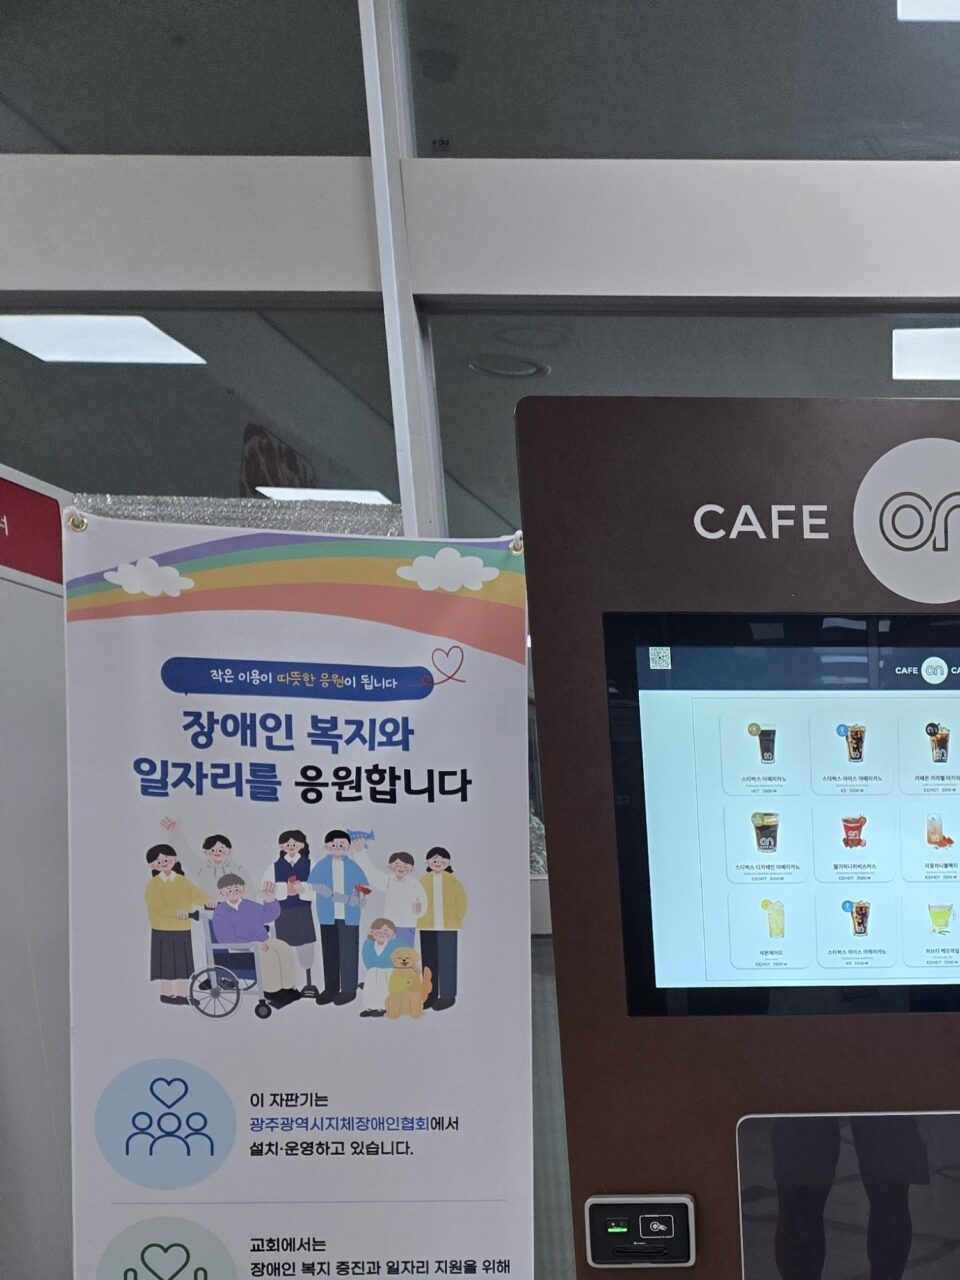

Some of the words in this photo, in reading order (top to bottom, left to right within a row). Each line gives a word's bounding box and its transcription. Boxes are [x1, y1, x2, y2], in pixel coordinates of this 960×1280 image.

[693, 503, 829, 540] CAFE
[210, 669, 234, 682] 작은
[238, 670, 272, 684] 이용이
[277, 671, 316, 687] 따뜻한
[319, 673, 356, 688] 응원이
[361, 674, 397, 690] 됩니다
[182, 710, 295, 751] 장애인
[307, 714, 415, 755] 복지와
[133, 757, 282, 801] 일자리를
[294, 763, 472, 804] 응원합니다
[250, 1093, 264, 1108] 이
[269, 1092, 328, 1108] 자판기는
[249, 1116, 459, 1132] 광주광역시지체장애인협회에서
[249, 1141, 345, 1156] 설치·운영하고
[350, 1141, 414, 1156] 있습니다.
[250, 1237, 327, 1252] 교회에서는
[250, 1261, 296, 1277] 장애인
[301, 1261, 330, 1276] 복지
[335, 1260, 381, 1276] 증진과
[386, 1260, 429, 1275] 일자리
[434, 1259, 477, 1275] 지원을
[481, 1259, 511, 1274] 위해
